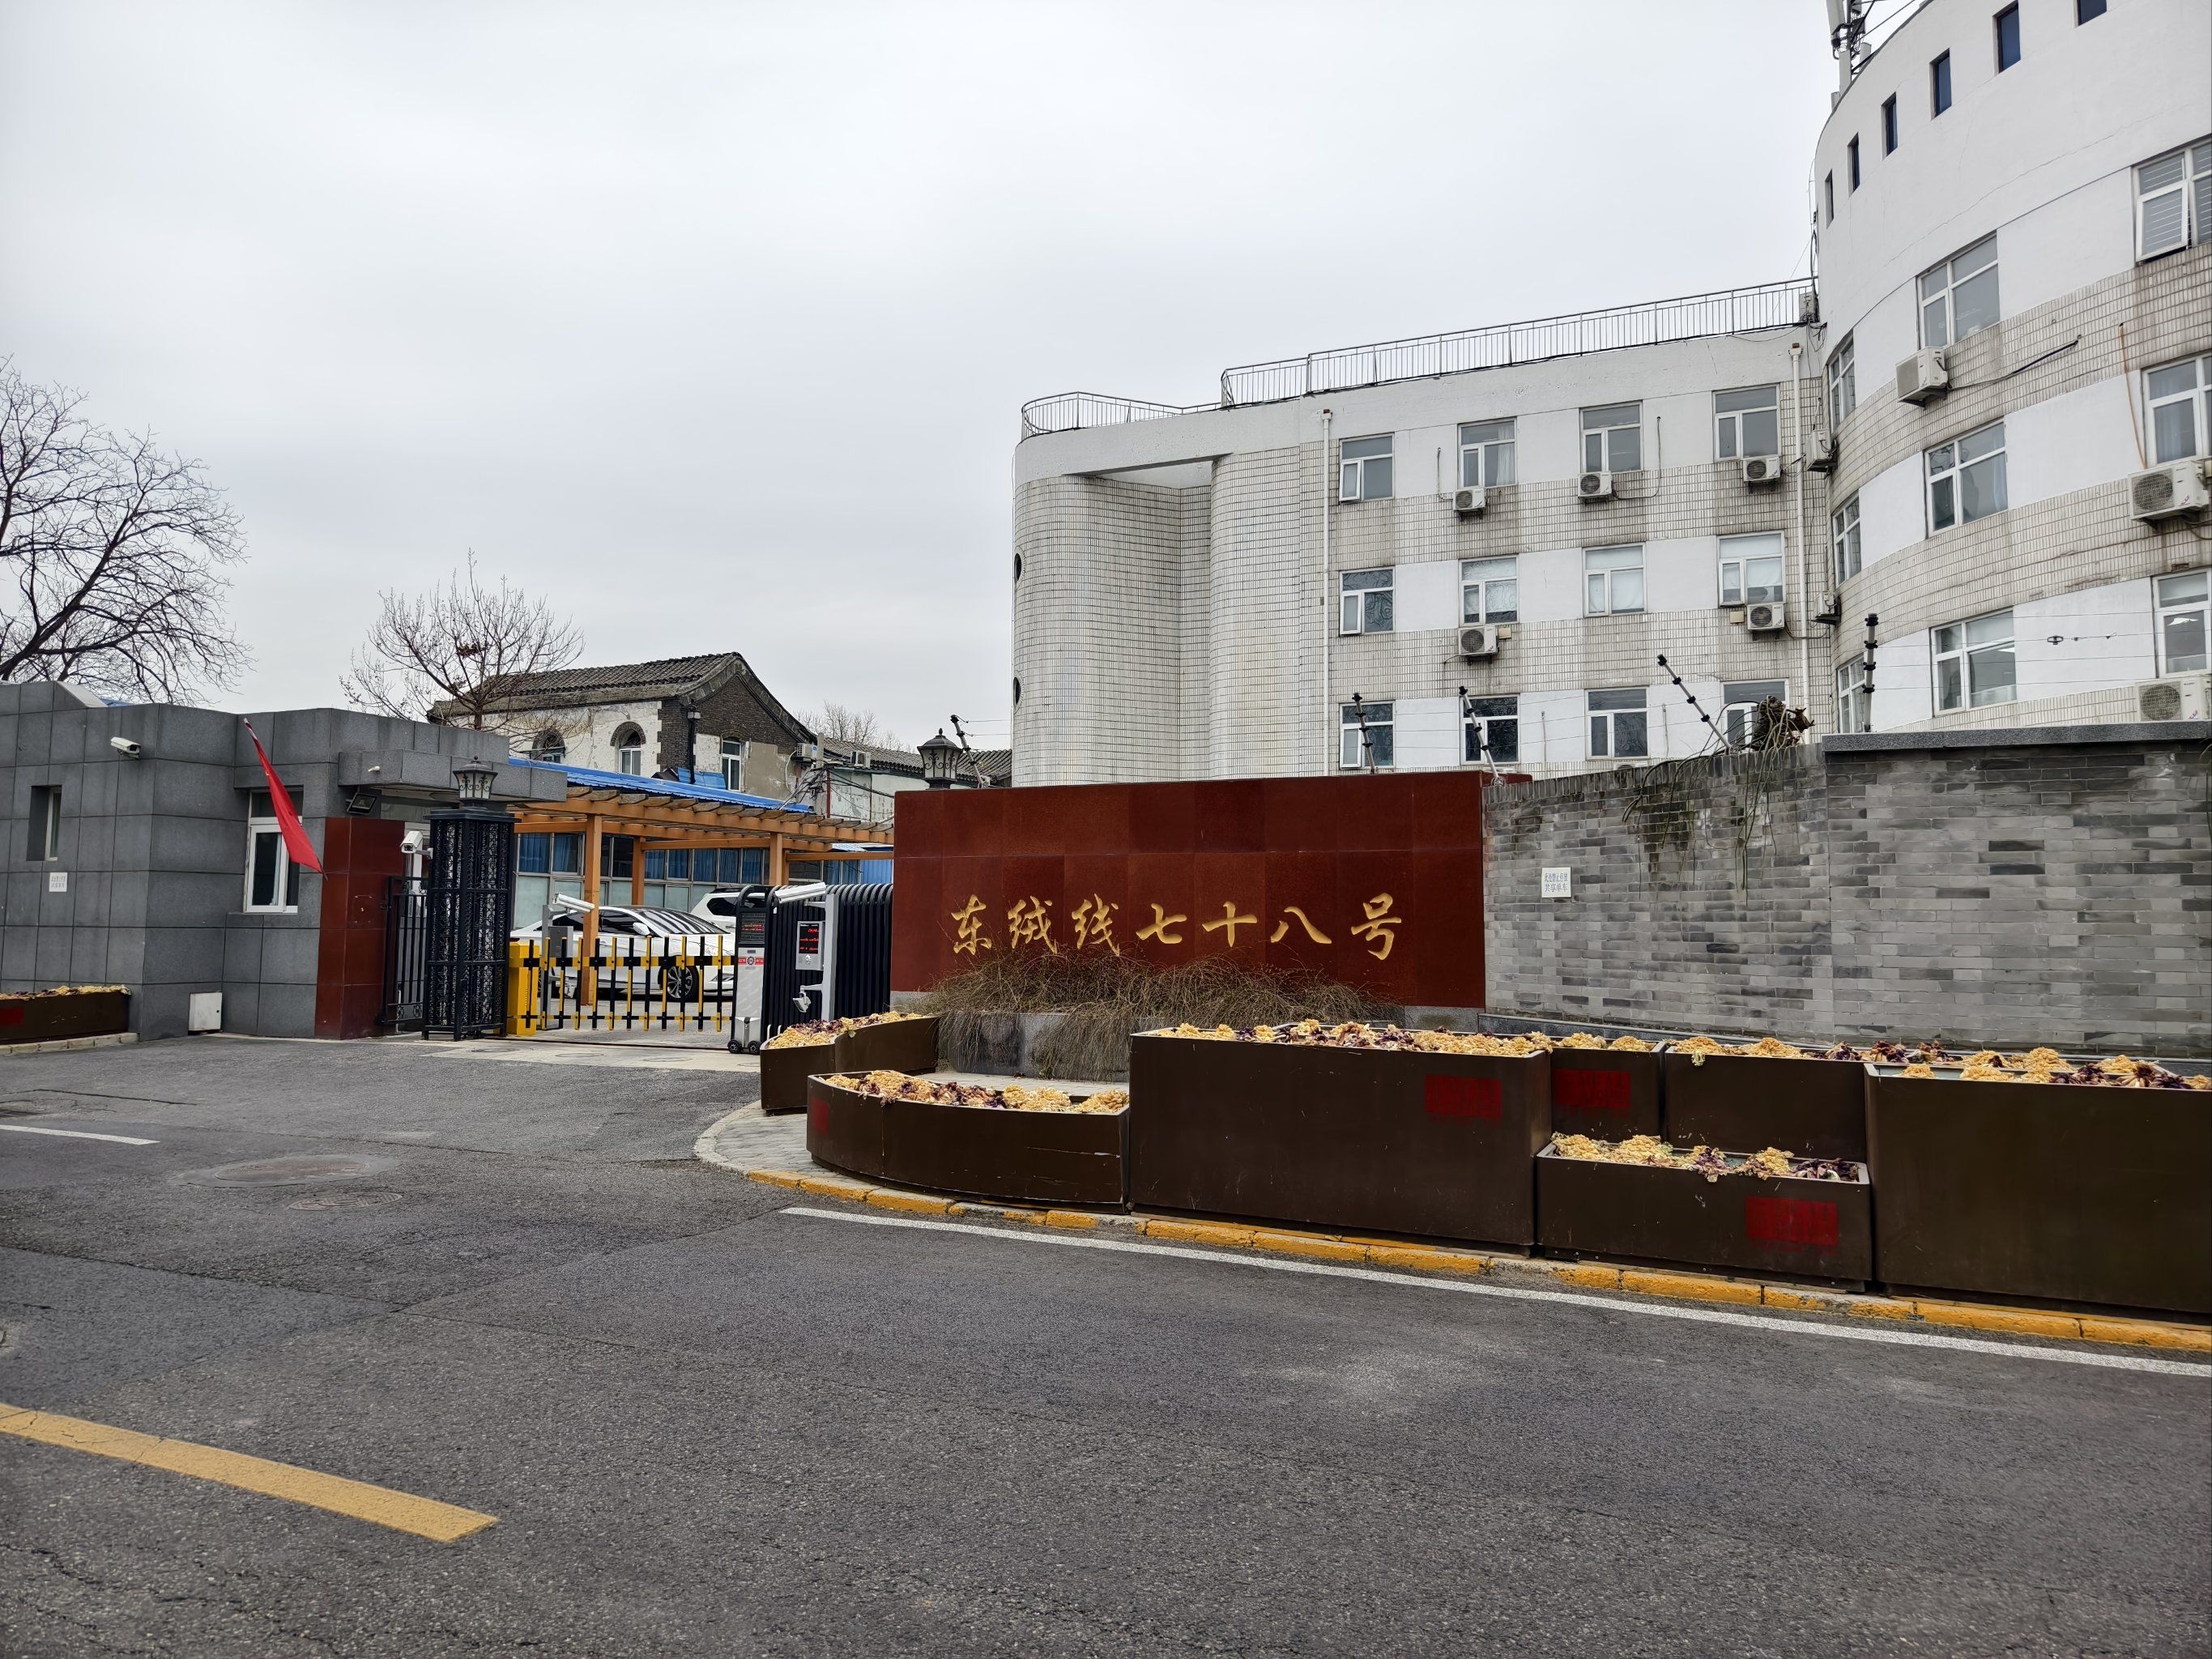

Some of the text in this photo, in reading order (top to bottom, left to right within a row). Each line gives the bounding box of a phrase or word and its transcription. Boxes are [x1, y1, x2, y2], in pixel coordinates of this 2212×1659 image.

[1544, 883, 1568, 893] 共享单车
[951, 893, 1402, 961] 东绒线七十八号
